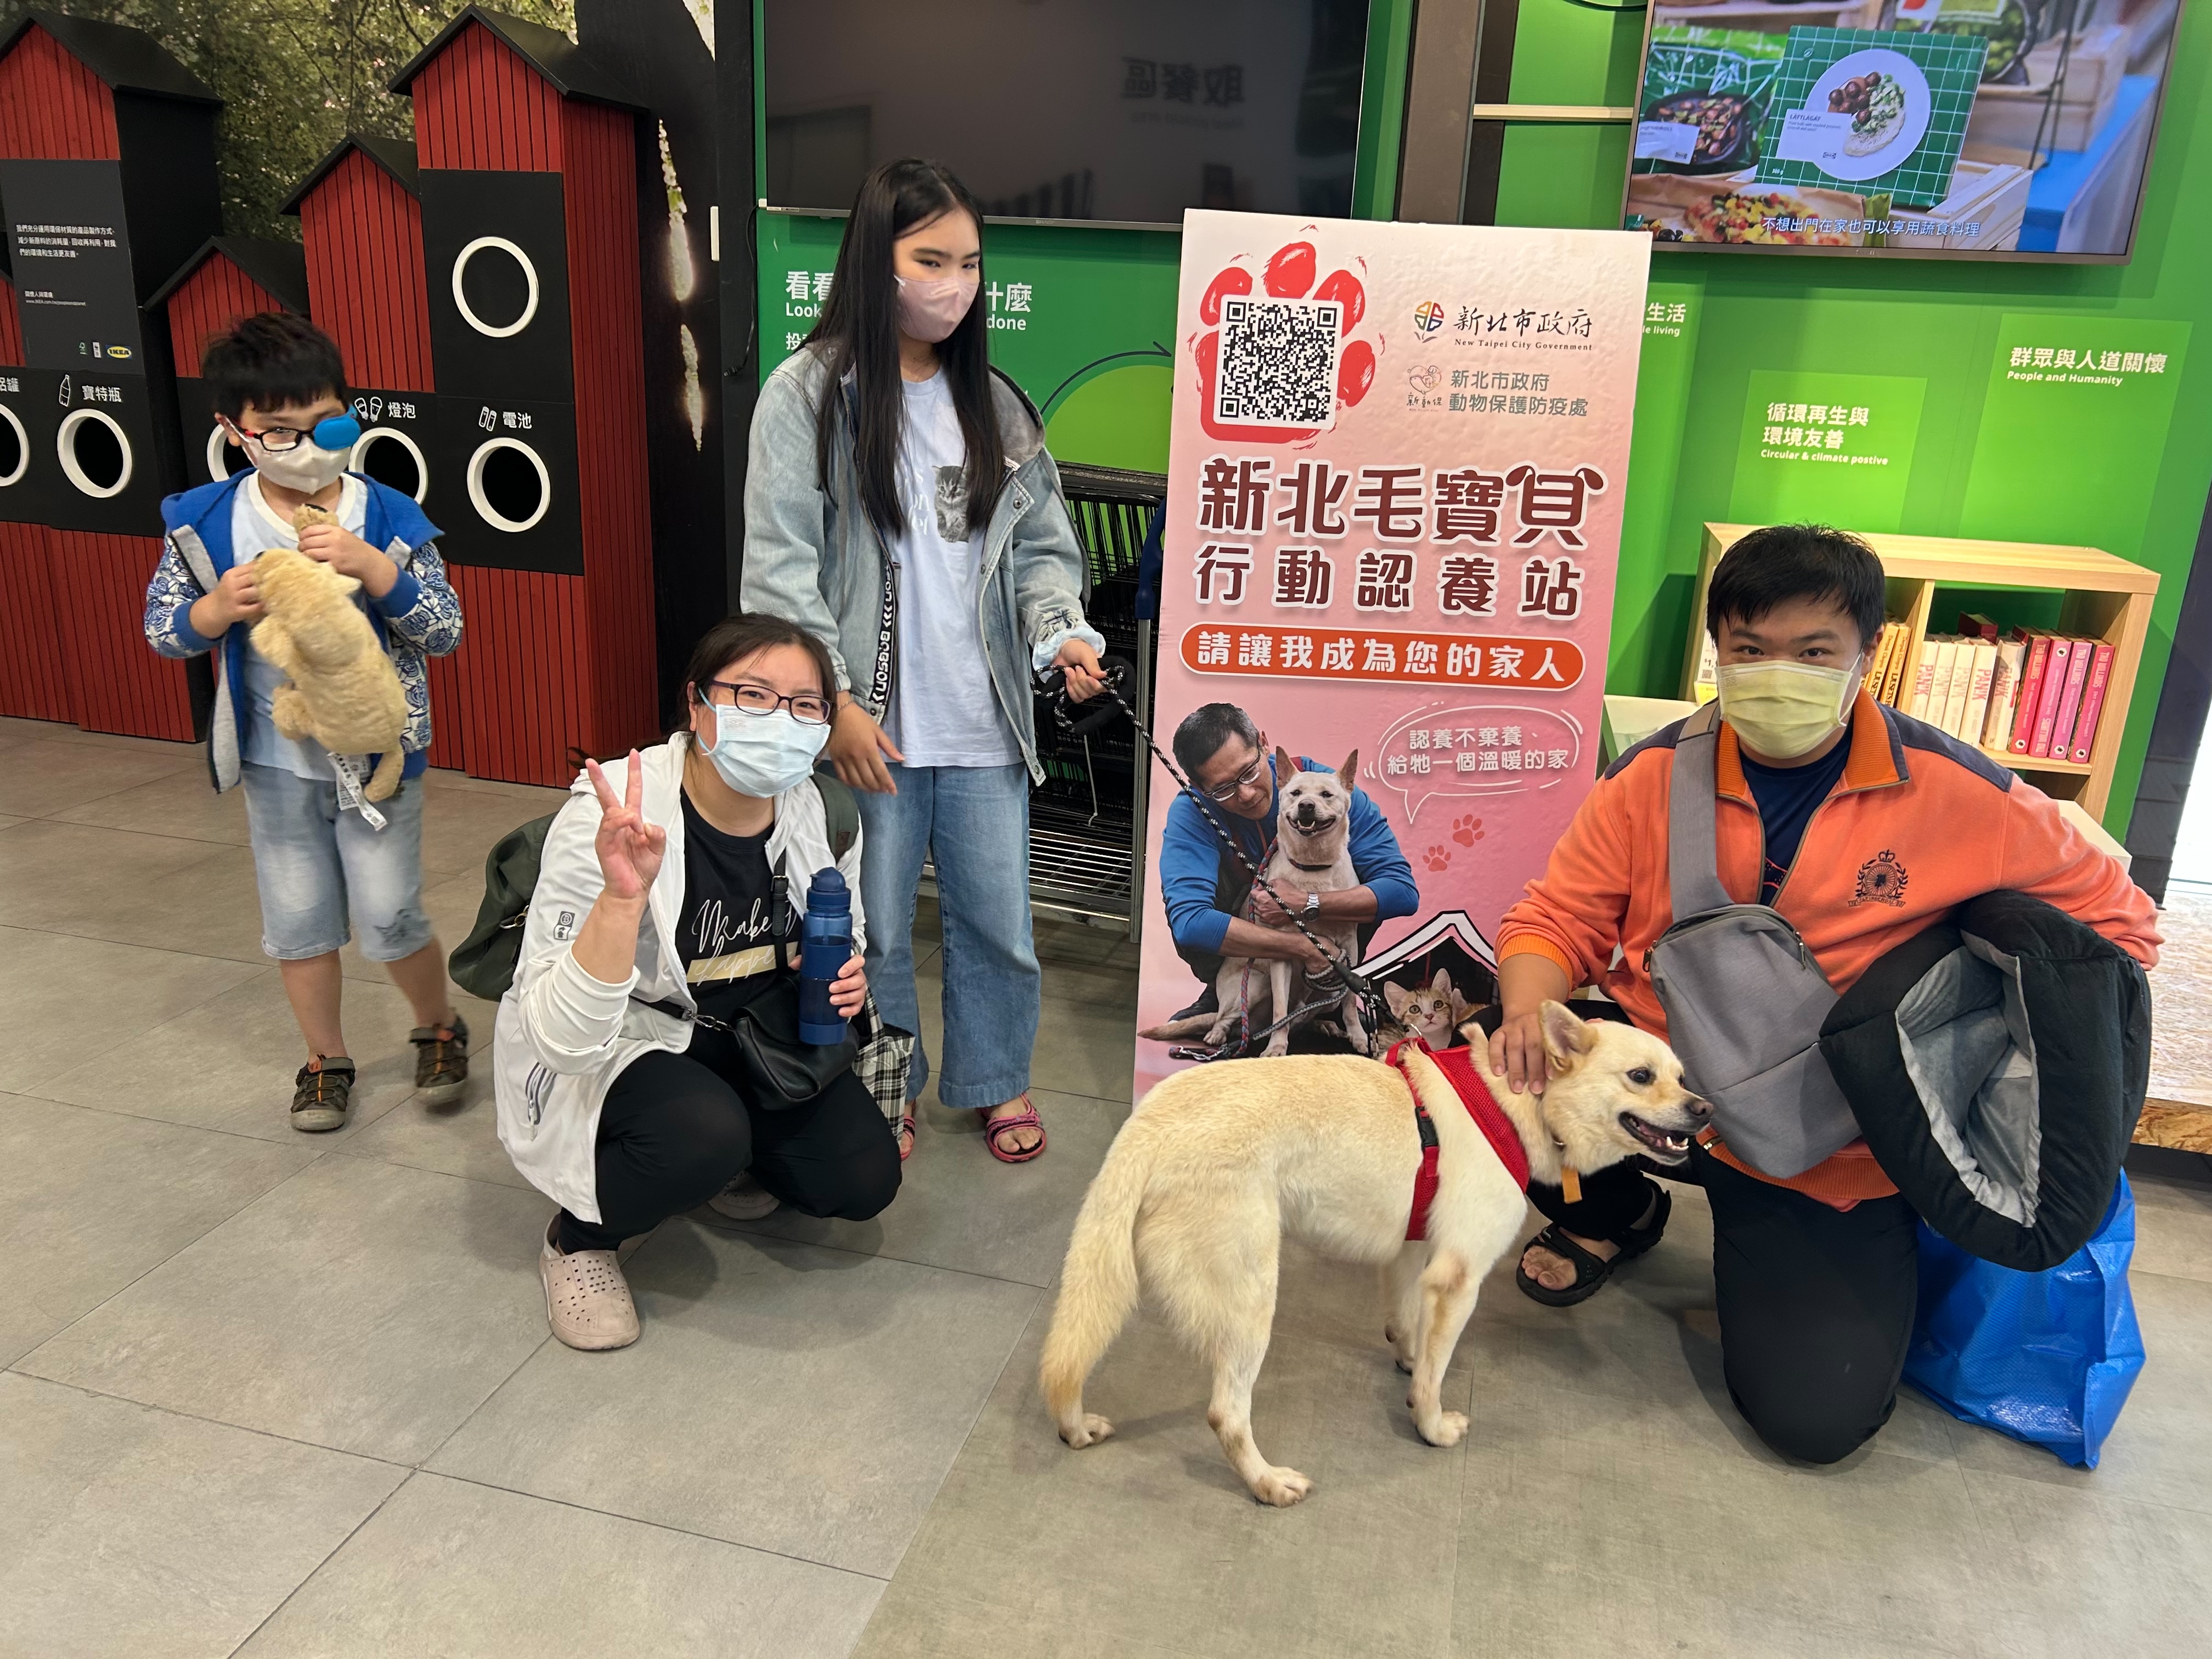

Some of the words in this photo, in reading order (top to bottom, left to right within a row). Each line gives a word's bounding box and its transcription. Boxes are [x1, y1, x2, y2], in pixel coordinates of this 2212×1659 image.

[1763, 217, 1980, 237] 不想出門在家也可以享用蔬食料理
[1454, 306, 1592, 337] 新北市政府
[1654, 325, 1680, 337] living
[1479, 340, 1508, 348] Taipei
[1512, 341, 1531, 349] City
[1536, 342, 1592, 351] Government
[2010, 347, 2168, 374] 群眾與人道關懷
[1451, 370, 1549, 392] 新北市政府
[2007, 371, 2043, 382] People
[2046, 373, 2066, 382] and
[2069, 374, 2123, 386] Humanity
[82, 385, 122, 403] 寶特瓶
[1449, 393, 1588, 417] 動物保護防疫處
[388, 402, 416, 419] 燈泡
[502, 411, 532, 429] 電池
[1767, 402, 1869, 427] 循環再生與
[1762, 426, 1844, 449] 環境友善
[1760, 449, 1800, 460] Circular
[1802, 452, 1809, 461] &
[1811, 451, 1848, 464] climate
[1850, 454, 1888, 466] postive
[1201, 458, 1604, 546] 新北毛寶貝
[1197, 545, 1580, 615] 行動認養站
[1198, 631, 1565, 682] 請讓我成為您的家人
[1409, 726, 1538, 750] 認養不棄養、
[1387, 748, 1568, 775] 給牠一個溫暖的家
[692, 898, 772, 953] Make
[695, 935, 776, 986] happe
